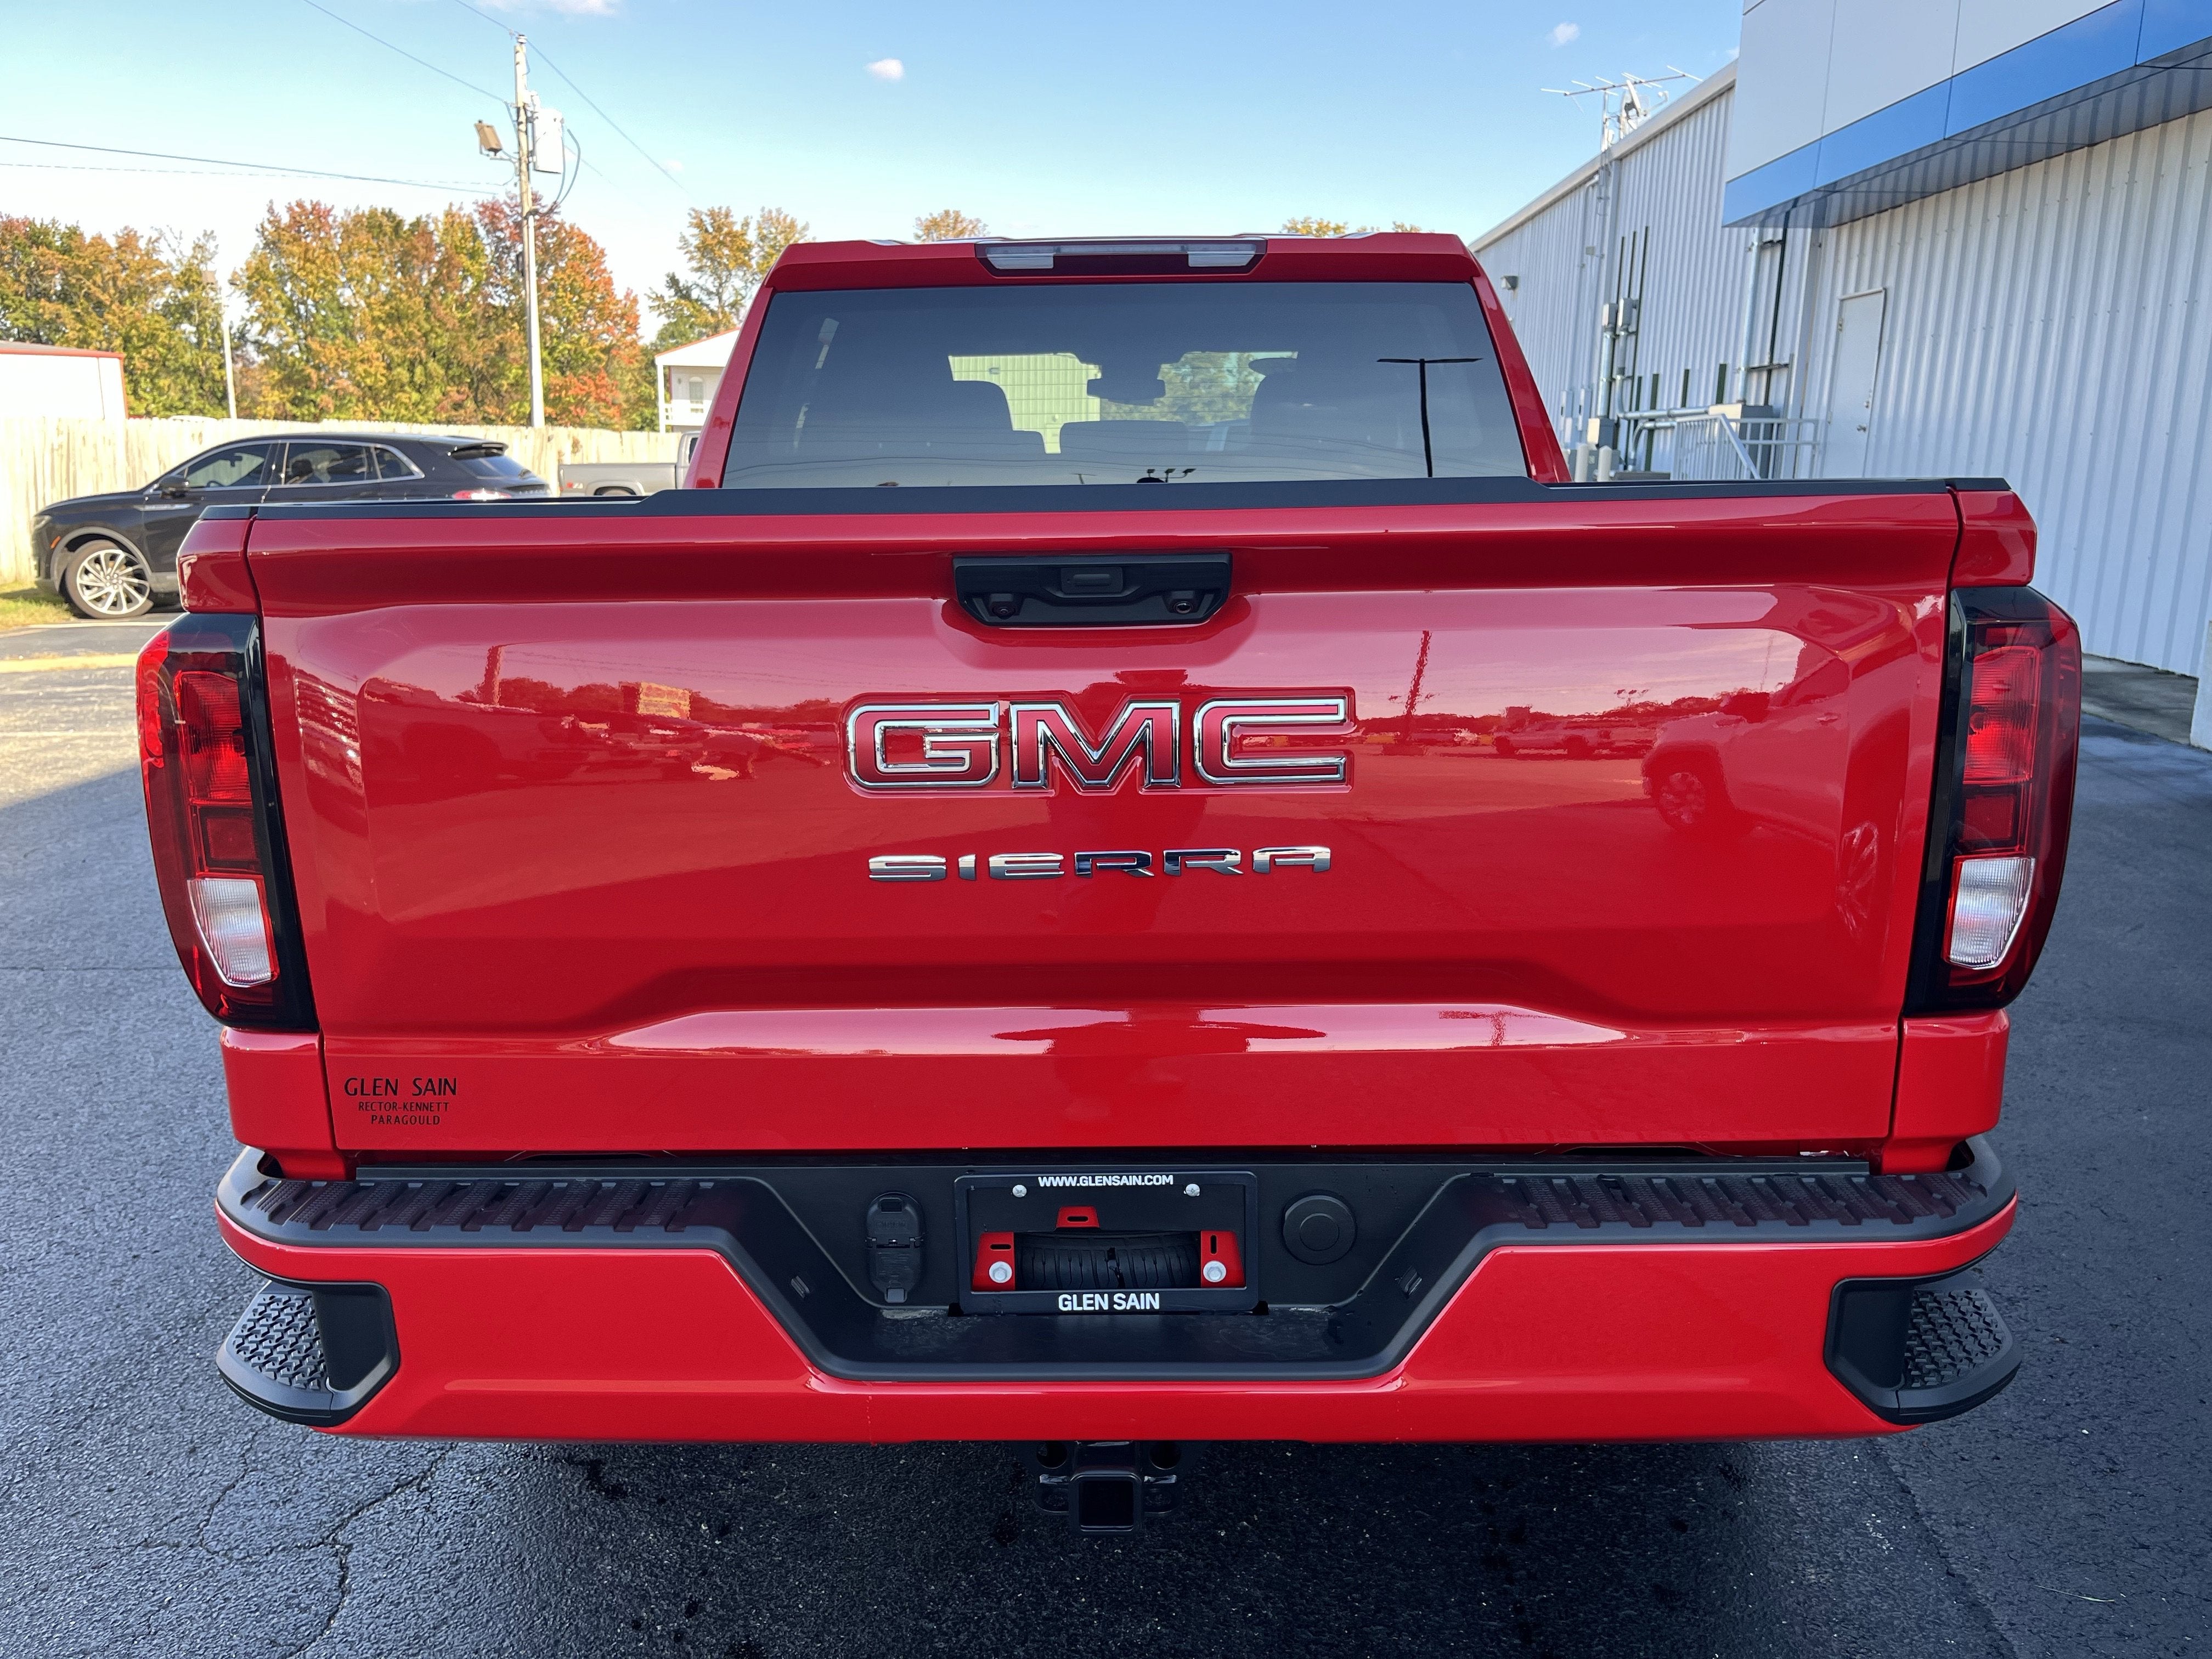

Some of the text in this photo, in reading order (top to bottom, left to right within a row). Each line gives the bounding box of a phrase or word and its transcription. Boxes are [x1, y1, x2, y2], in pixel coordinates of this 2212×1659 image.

[847, 698, 1347, 788] GMC
[868, 846, 1331, 881] SIERRA
[344, 1077, 456, 1096] GLEN SAIN
[358, 1101, 450, 1112] RECTOR-KENNETT
[371, 1114, 441, 1125] PARAGOULD
[1038, 1175, 1173, 1187] WWW.GLENSAIN.COM
[1058, 1293, 1160, 1311] GLEN SAIN
